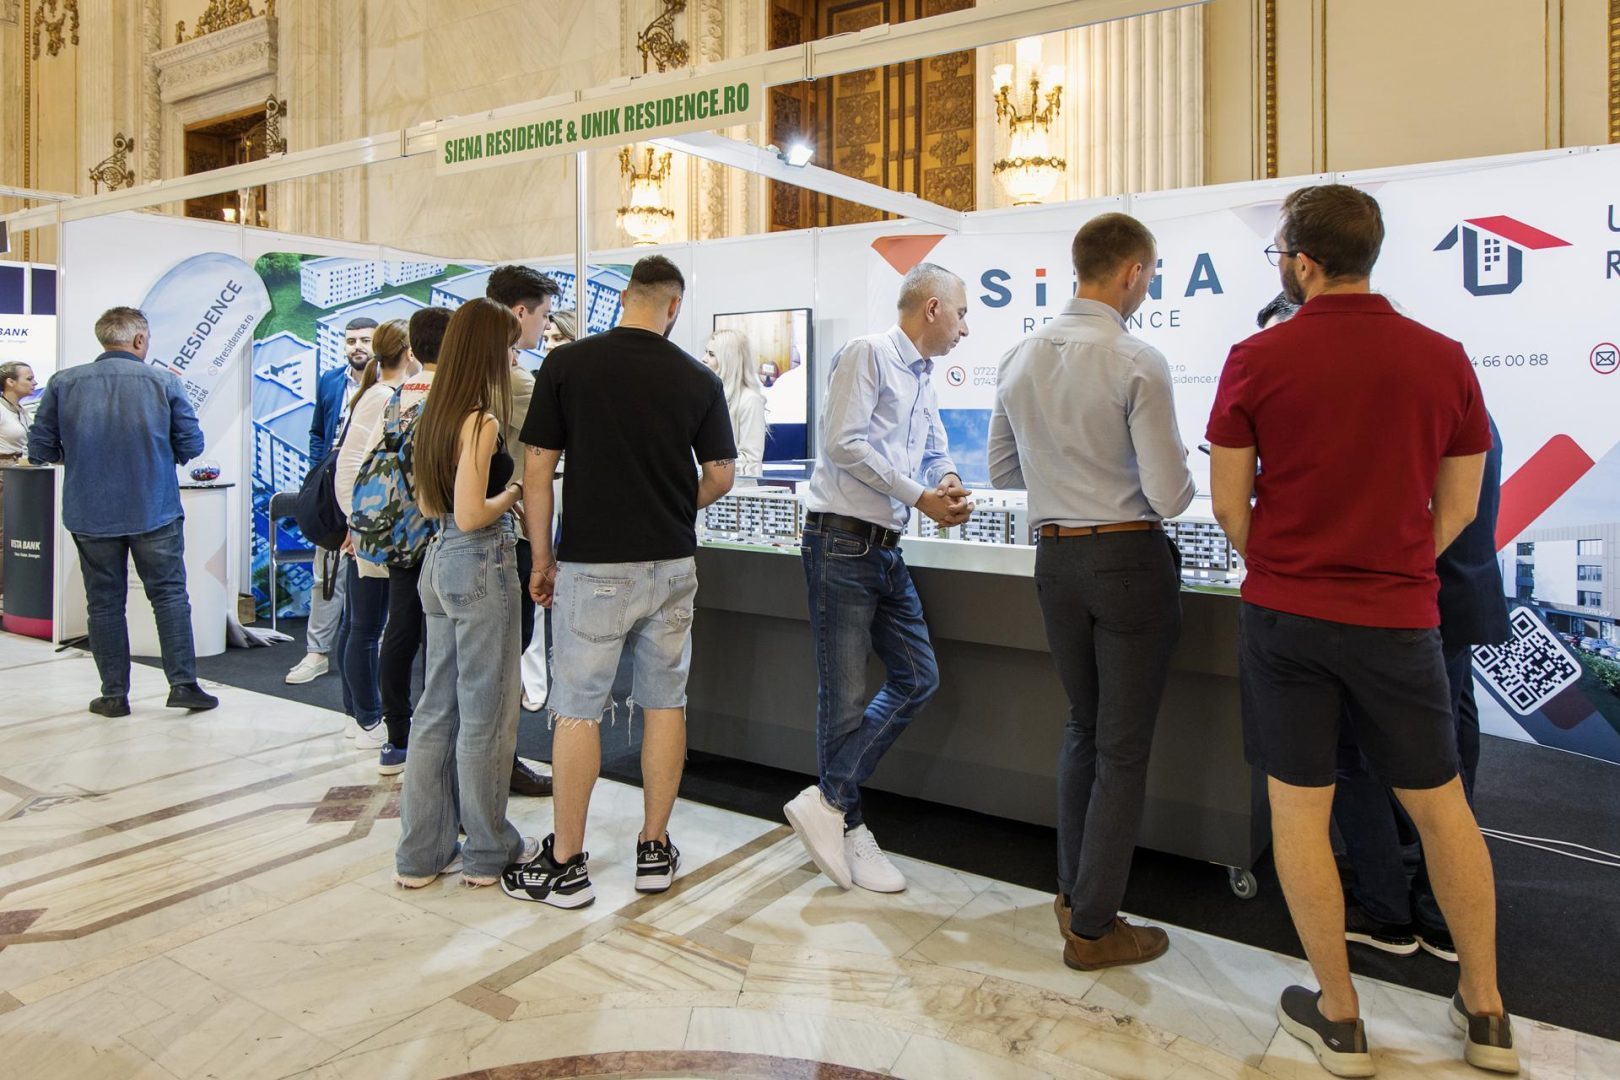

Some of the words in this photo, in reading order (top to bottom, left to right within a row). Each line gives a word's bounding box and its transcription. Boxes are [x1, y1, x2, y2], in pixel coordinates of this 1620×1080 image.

[445, 134, 483, 164] SIENA
[486, 119, 563, 157] RESIDENCE
[566, 120, 578, 143] &
[581, 108, 621, 140] UNIK
[624, 82, 749, 132] RESIDENCE.RO
[213, 314, 255, 368] 81residence.ro
[1482, 355, 1501, 367] 66
[1505, 354, 1525, 367] 00
[1529, 353, 1549, 366] 88
[1171, 374, 1219, 384] sidence.r
[22, 541, 41, 550] BANK
